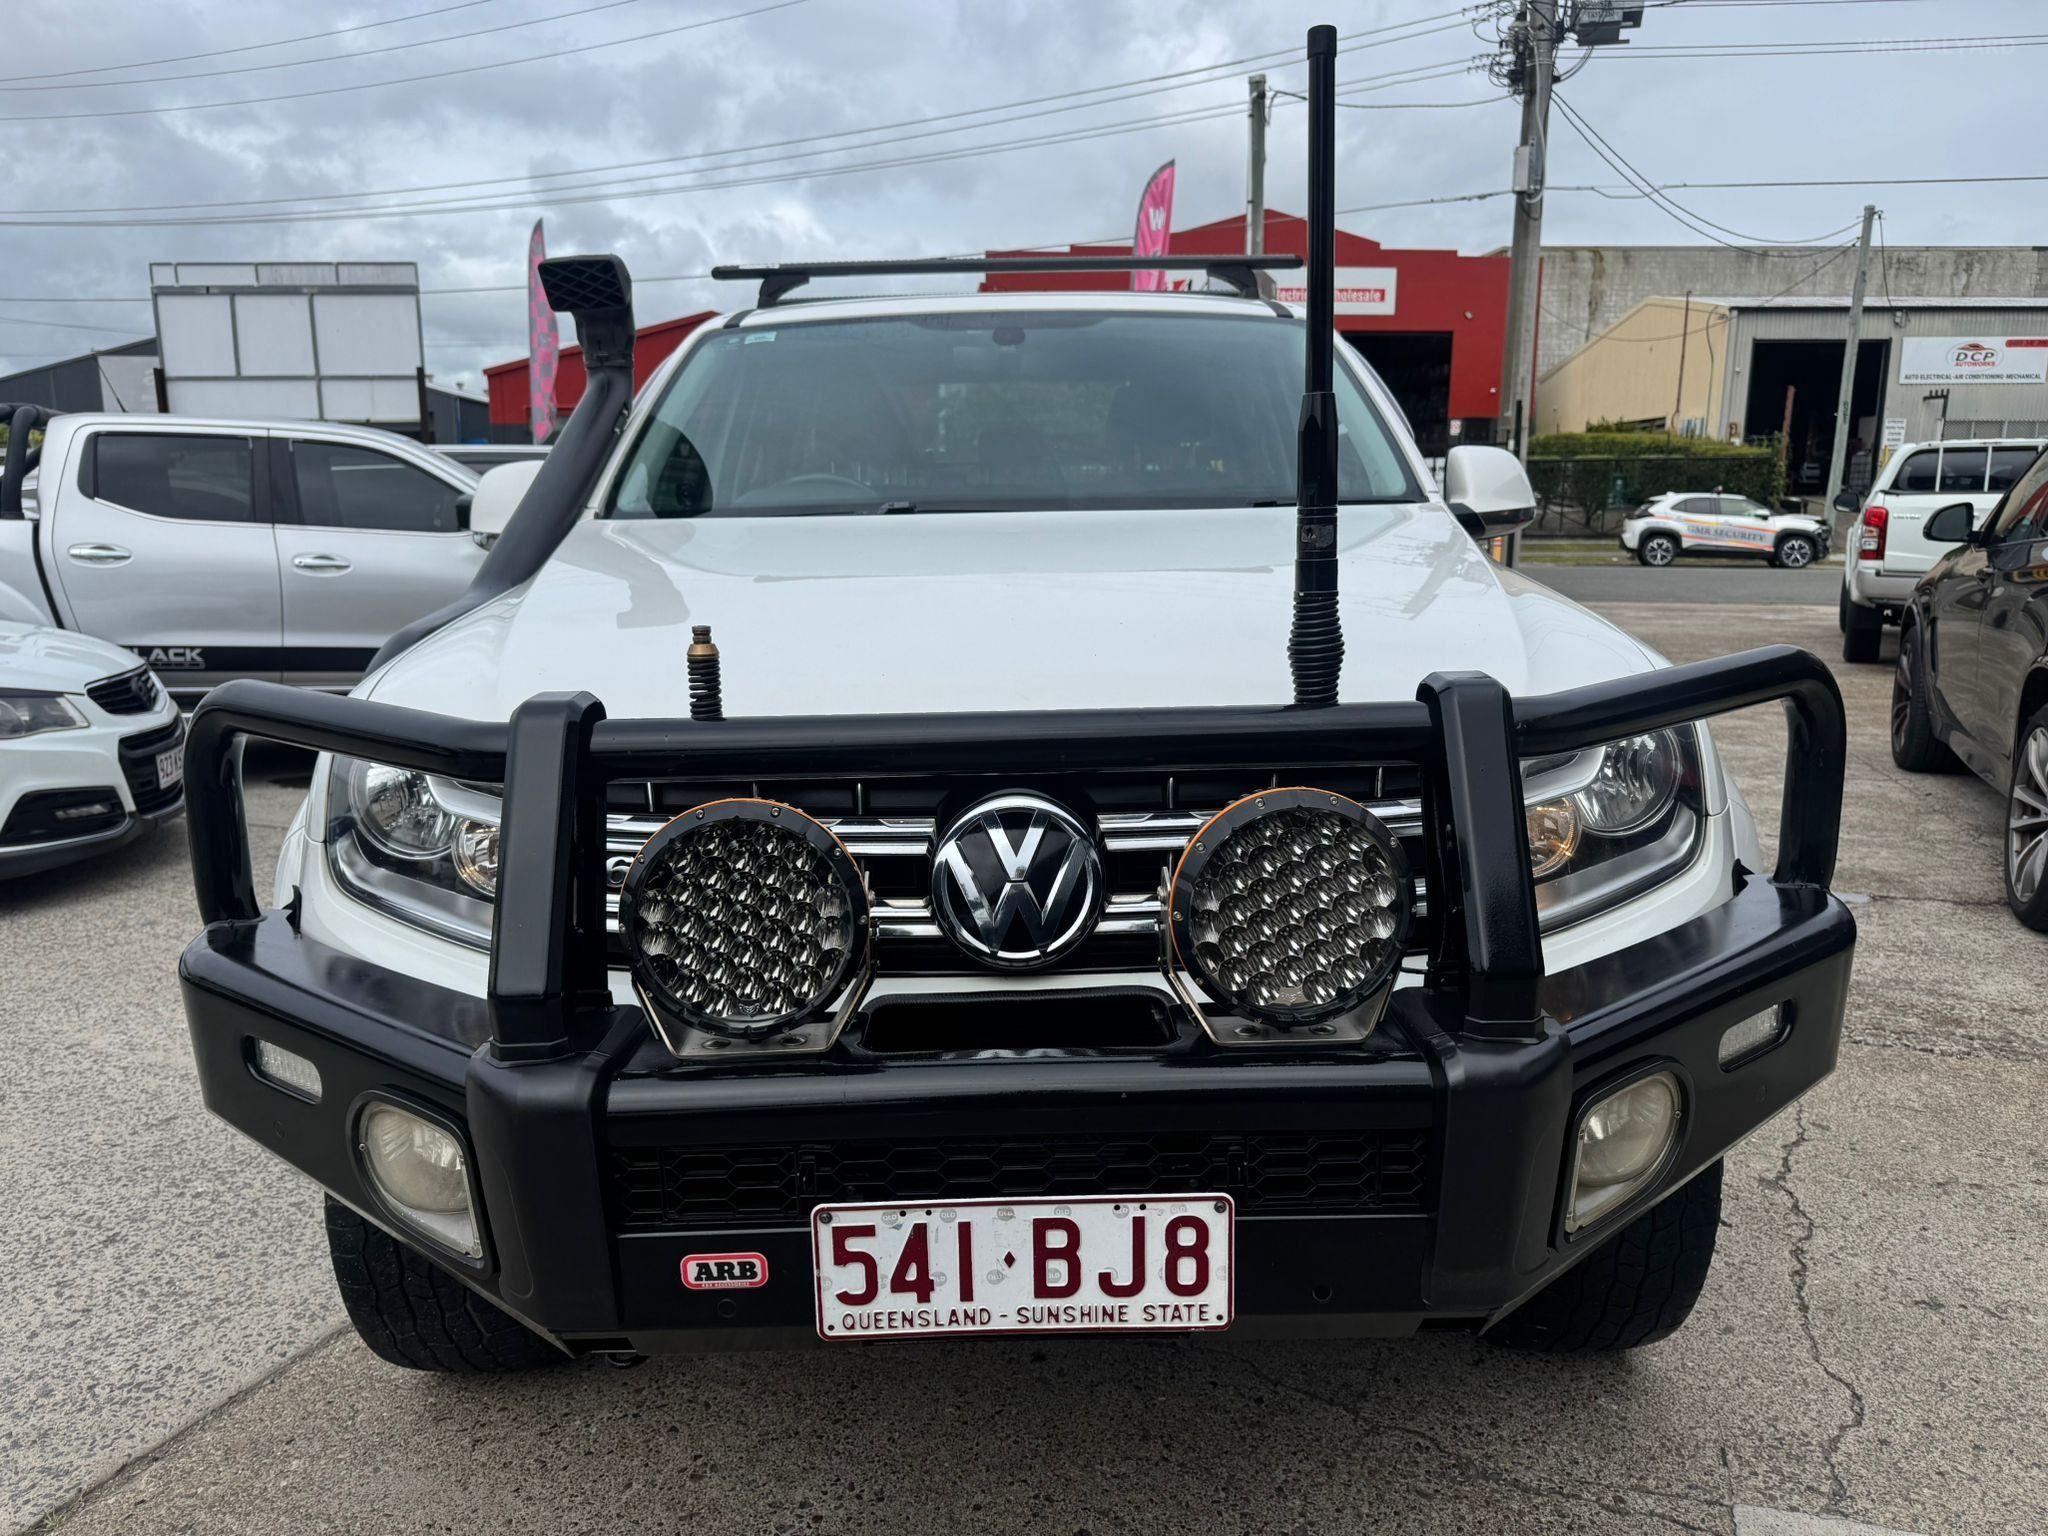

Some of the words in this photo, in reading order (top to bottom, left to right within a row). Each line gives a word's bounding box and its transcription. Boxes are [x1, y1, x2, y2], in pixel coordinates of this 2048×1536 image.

[1955, 352, 1994, 361] DCP
[1713, 527, 1766, 541] SECURITY
[132, 648, 204, 662] LACK
[831, 1221, 974, 1306] 541
[1033, 1215, 1210, 1299] BJ8
[694, 1261, 758, 1282] ARB
[842, 1307, 991, 1330] QUEENSLAND
[1017, 1304, 1128, 1324] SUNSHINE
[1143, 1303, 1210, 1322] STATE
